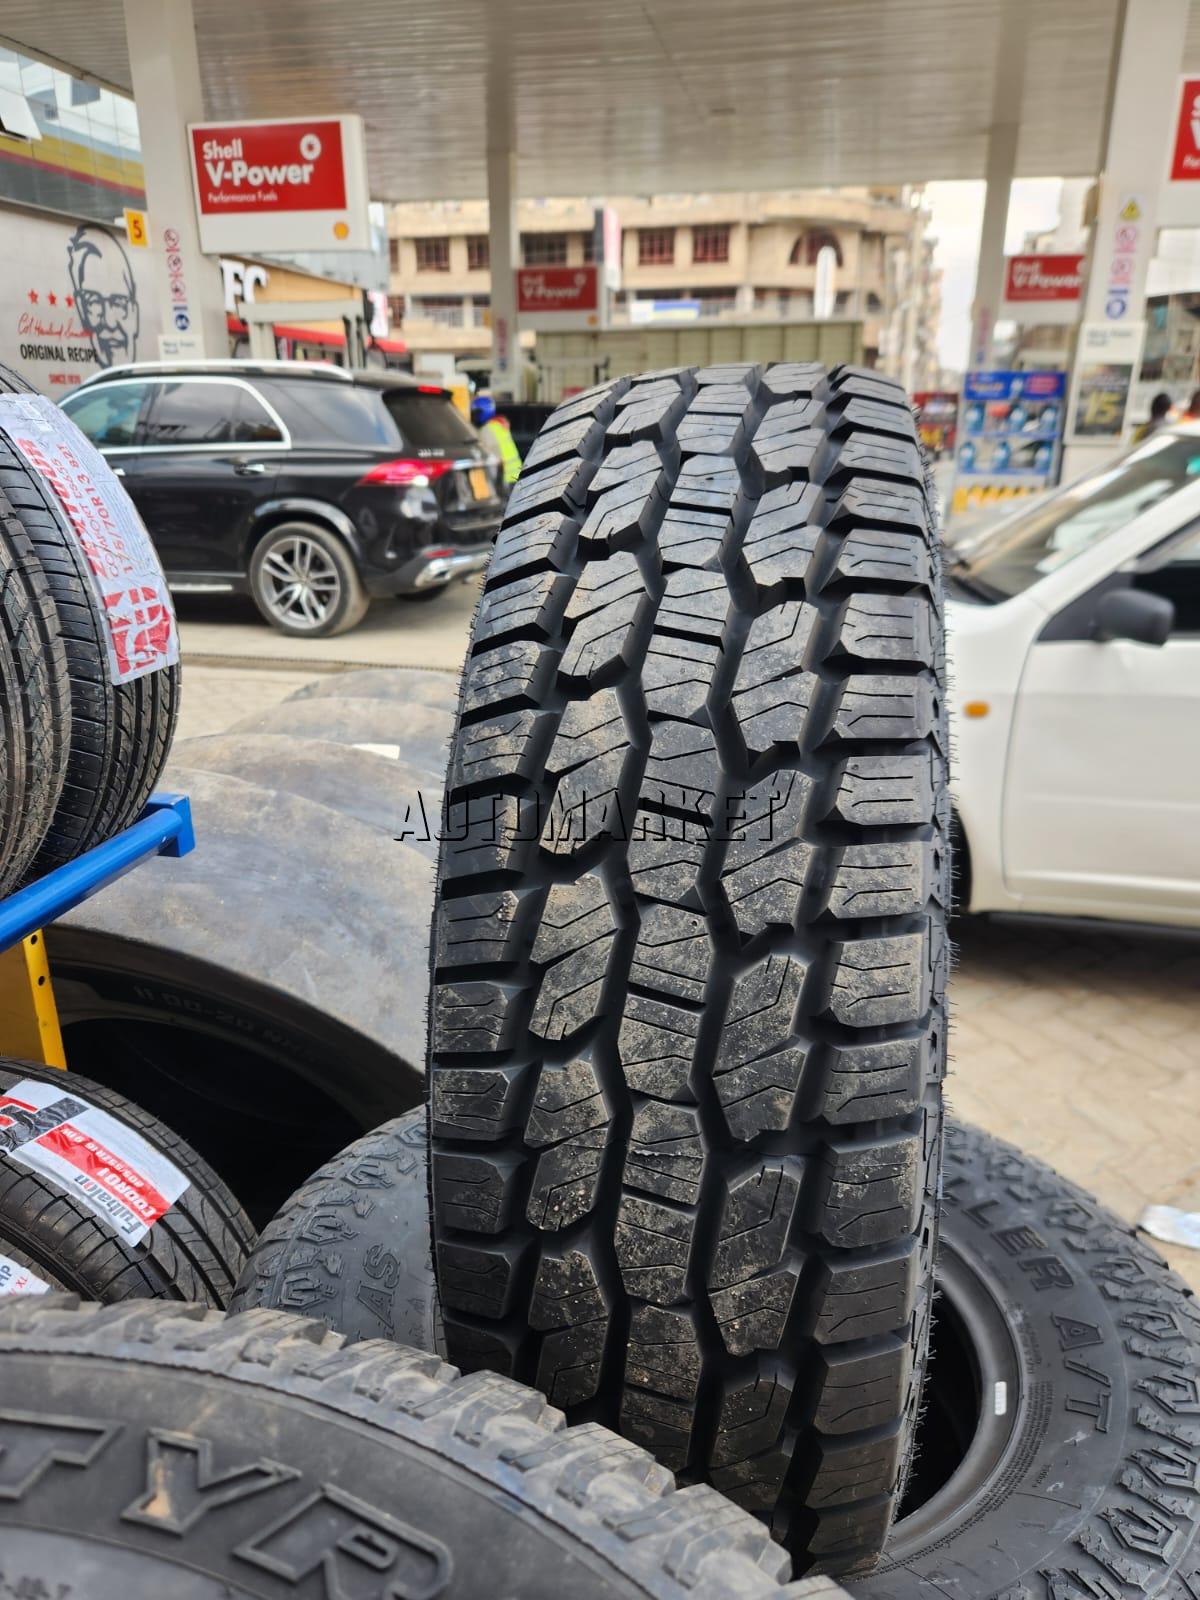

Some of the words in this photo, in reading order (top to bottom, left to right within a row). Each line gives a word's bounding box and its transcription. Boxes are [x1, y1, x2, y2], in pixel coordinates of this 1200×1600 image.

[202, 138, 243, 160] Shell
[204, 160, 314, 188] V-Power
[133, 219, 142, 239] 5
[20, 344, 65, 361] ORIGINAL
[1051, 1313, 1113, 1433] A/T
